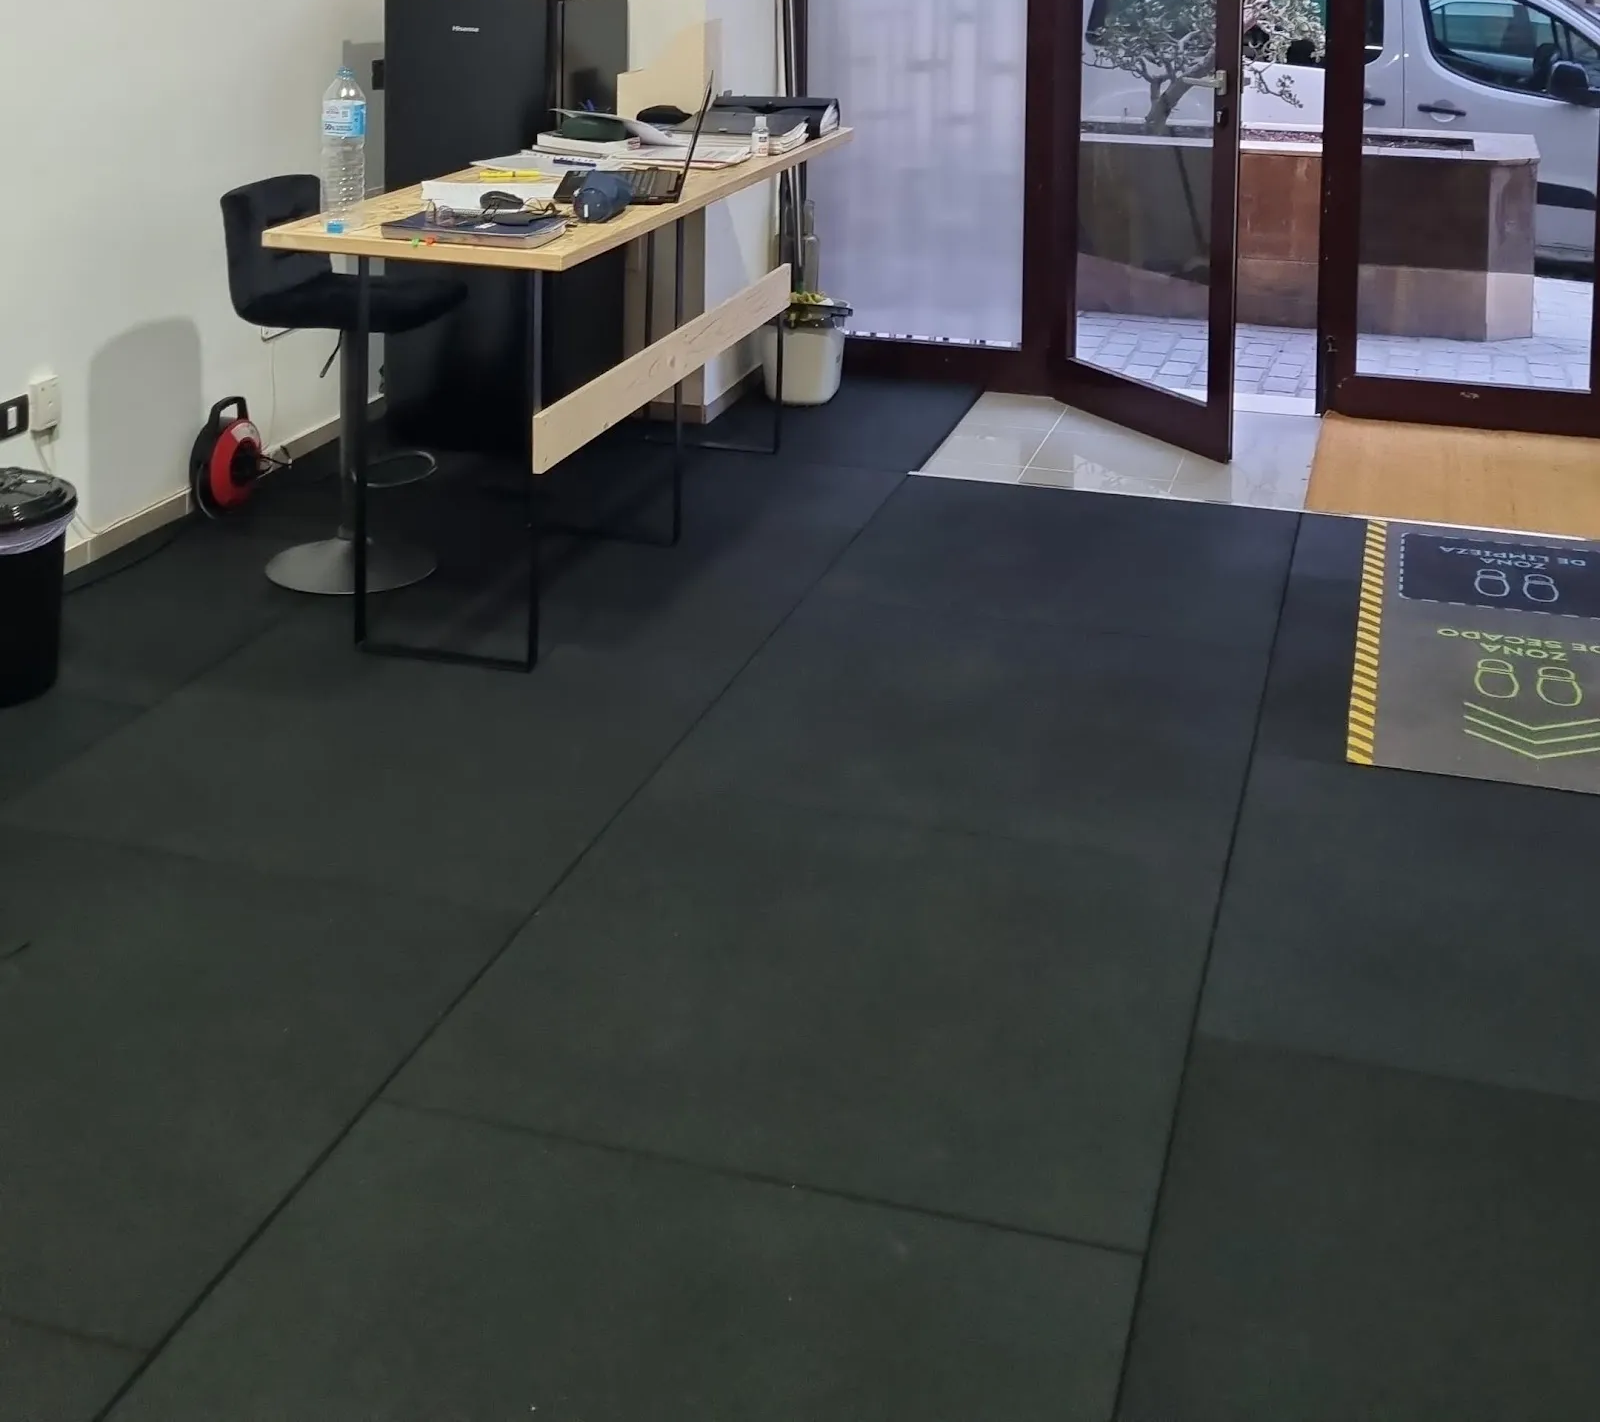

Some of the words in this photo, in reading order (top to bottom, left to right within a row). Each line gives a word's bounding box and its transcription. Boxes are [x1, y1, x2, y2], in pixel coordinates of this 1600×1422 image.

[1439, 546, 1549, 563] LIMPIEZA
[1558, 557, 1586, 566] DE
[1480, 557, 1547, 570] ZONA
[1437, 628, 1562, 649] SECADO
[1480, 642, 1568, 661] ZONA
